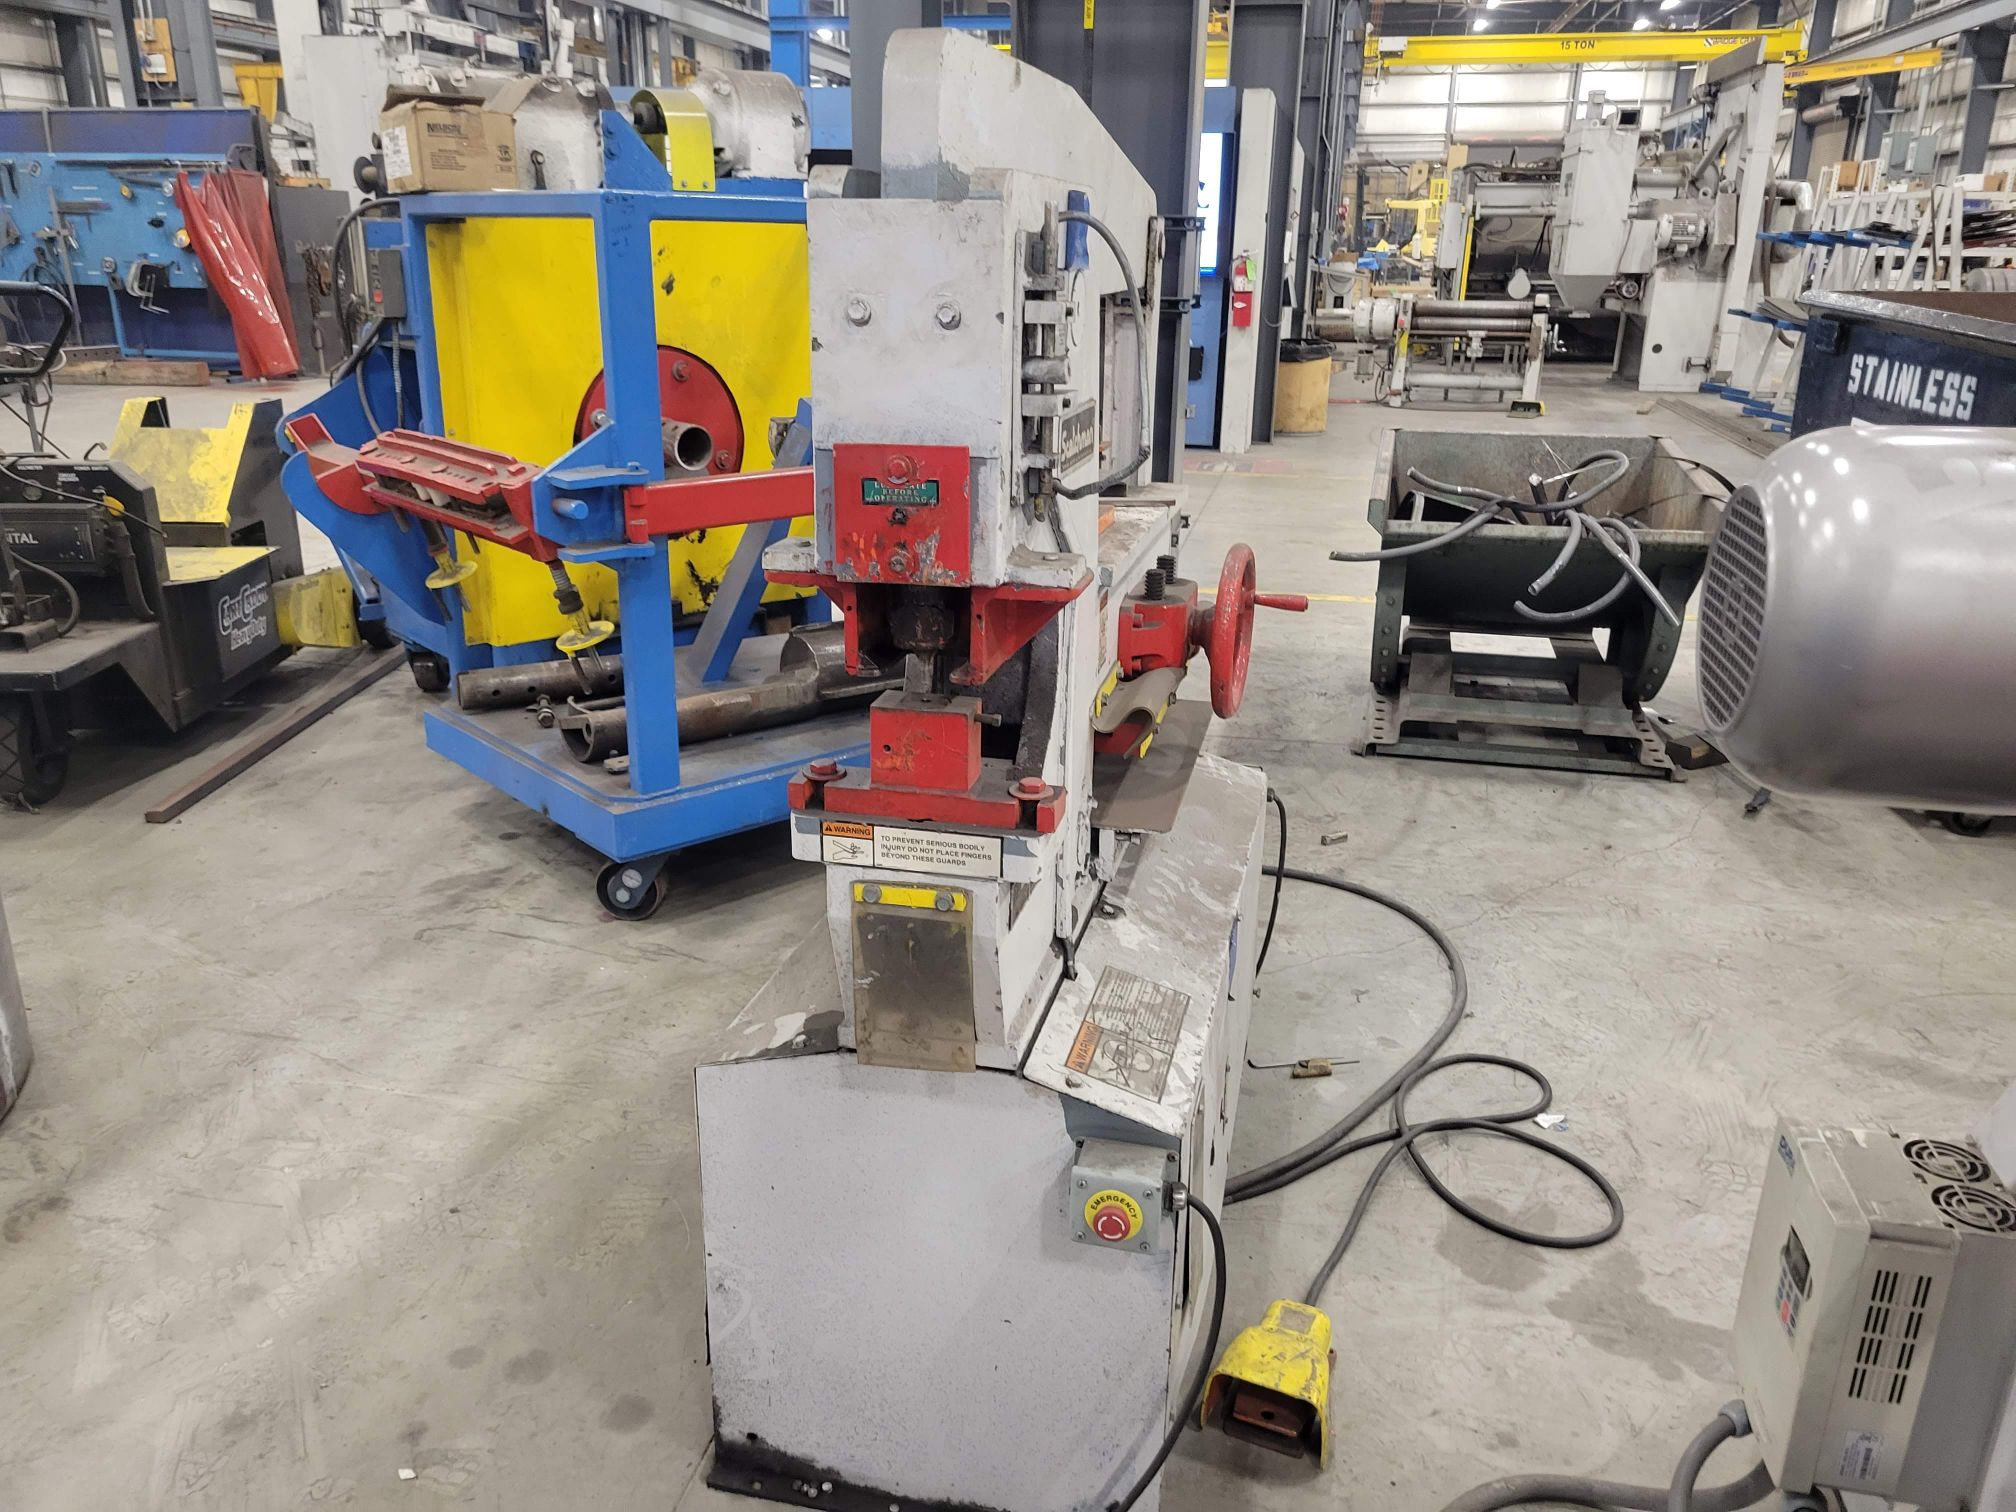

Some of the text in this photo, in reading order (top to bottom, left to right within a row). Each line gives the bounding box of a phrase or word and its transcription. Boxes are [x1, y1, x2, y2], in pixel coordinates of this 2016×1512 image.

[1561, 40, 1595, 50] 15 TON
[1847, 353, 1978, 421] STAINLESS
[874, 494, 927, 504] OPERATING
[834, 826, 871, 836] WARNING
[892, 836, 924, 846] PREVENT
[926, 840, 957, 848] SERIOUS
[959, 843, 985, 851] BODILY
[880, 844, 905, 852] INJURY
[936, 850, 960, 858] PLACE
[961, 852, 992, 861] FINGERS
[881, 852, 967, 867] BEYOND THESE GUARDS
[1091, 1195, 1138, 1219] EMERGENCY
